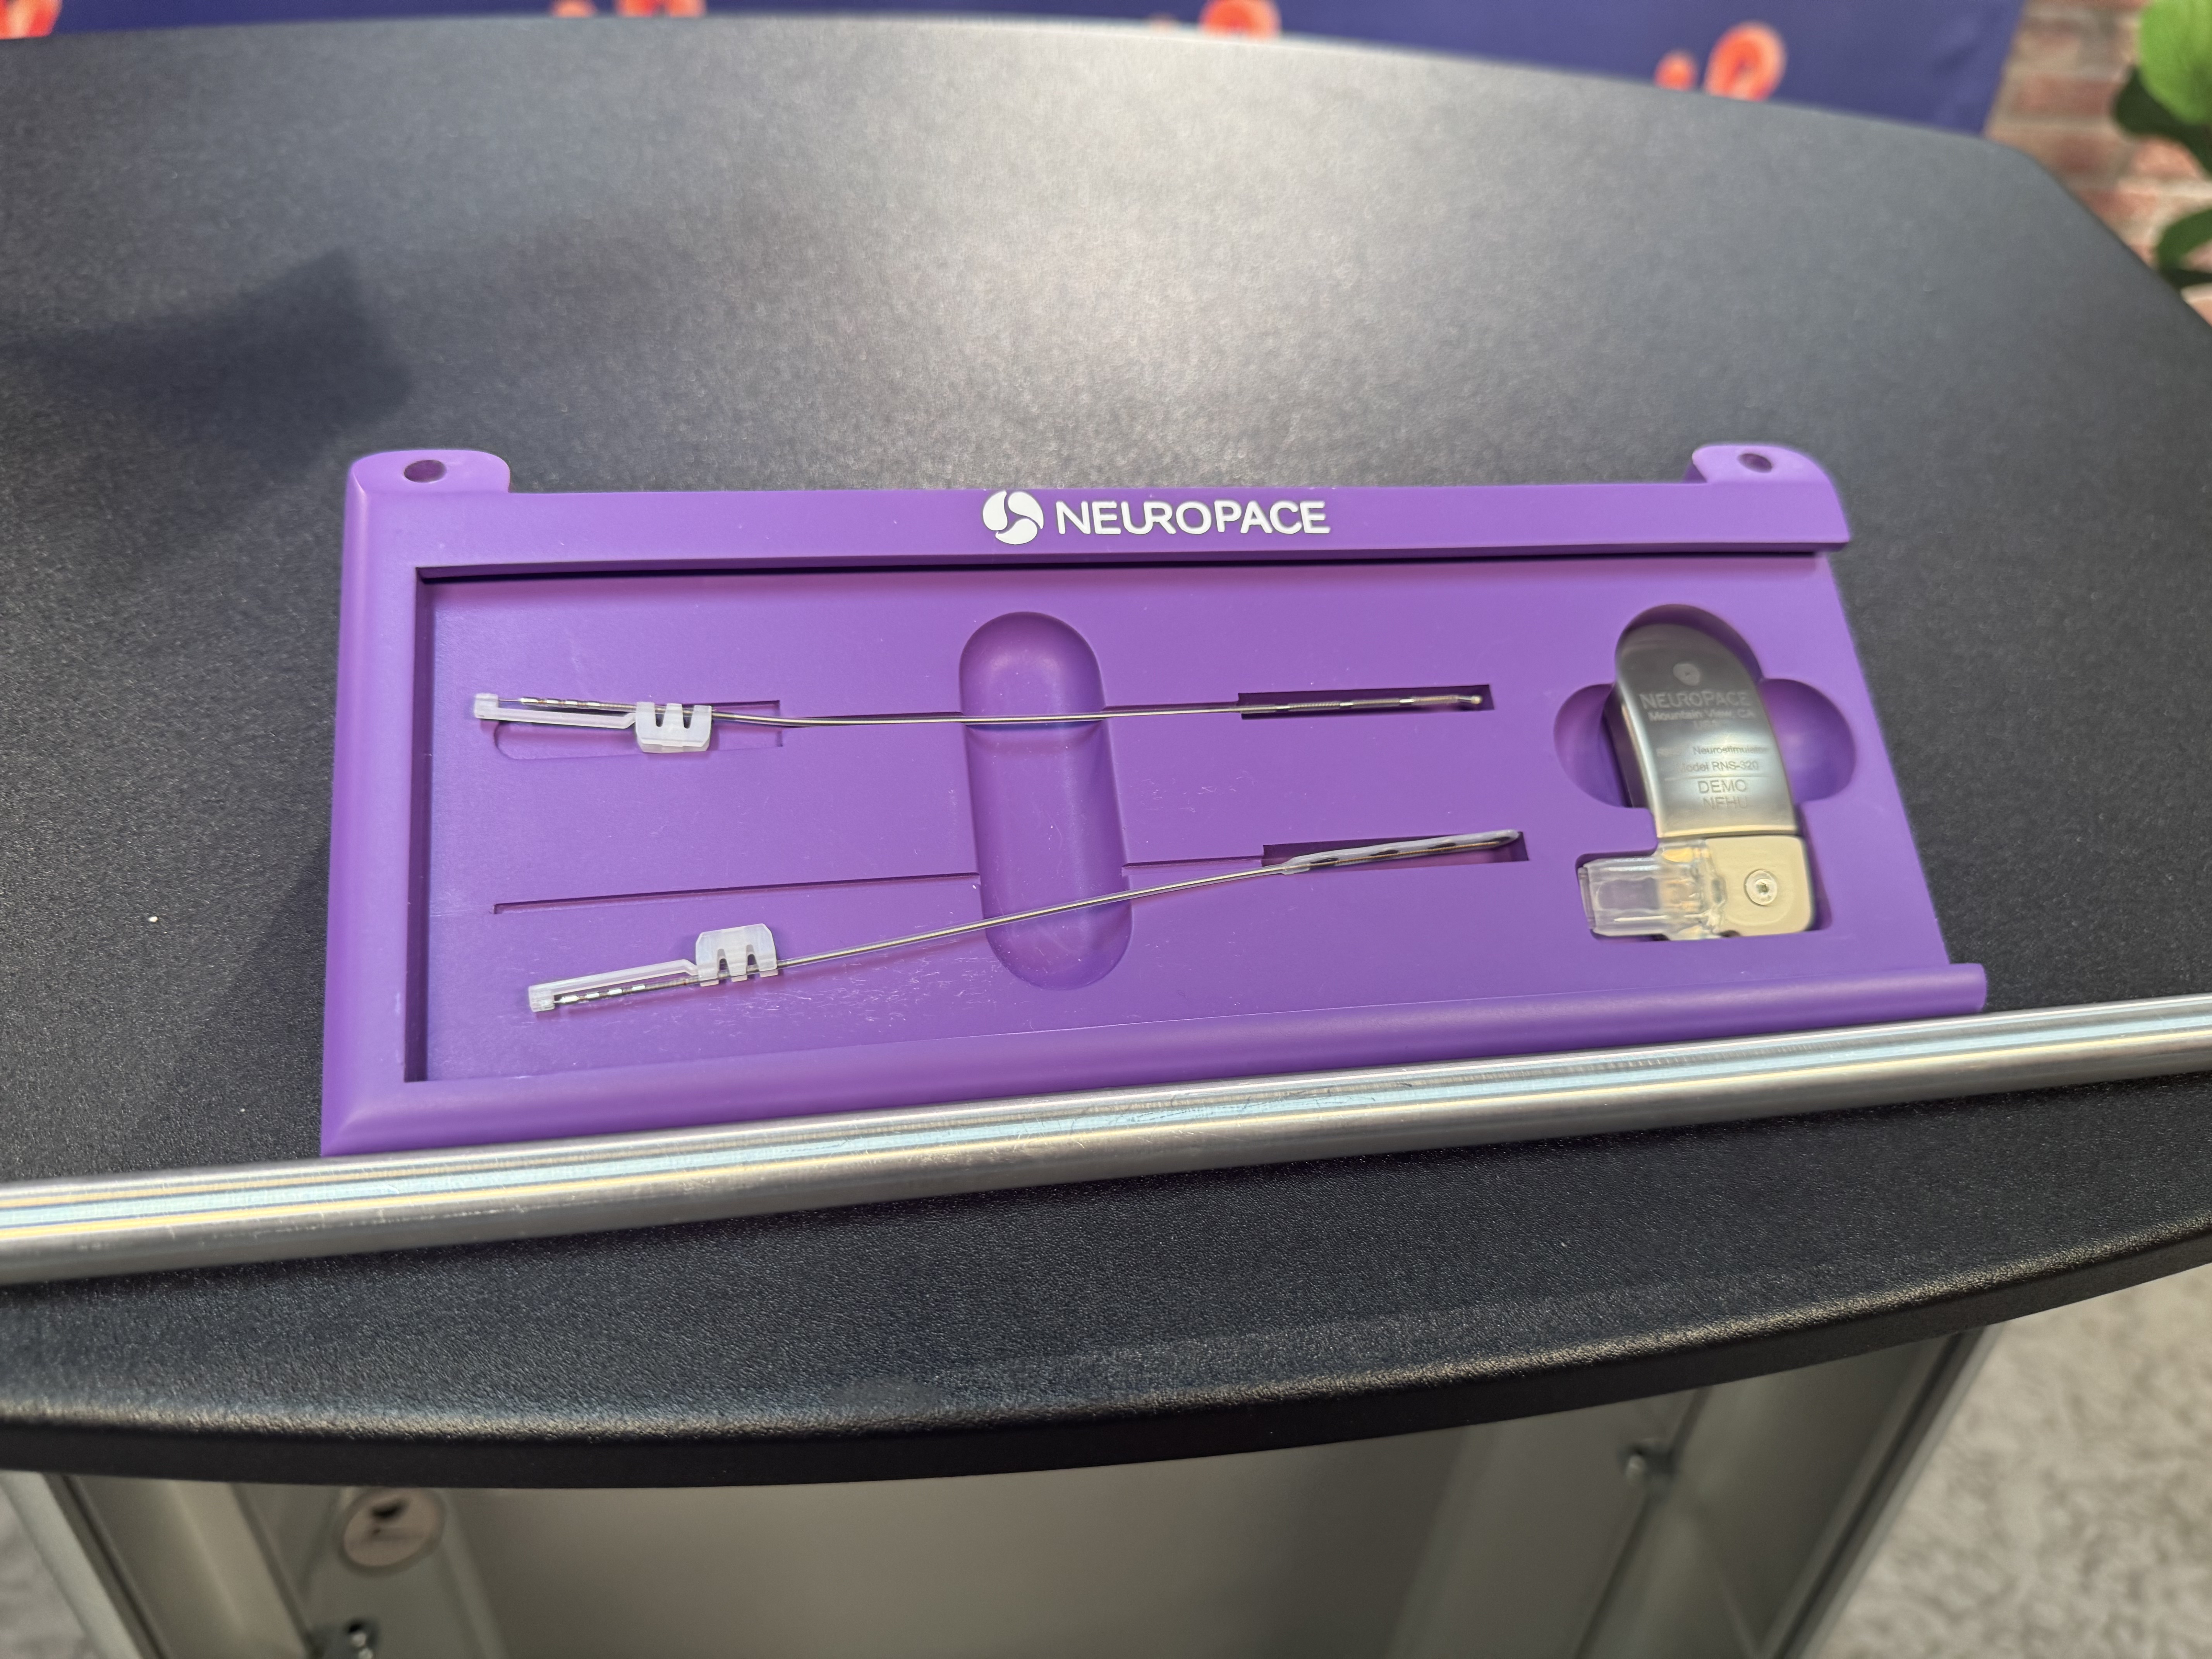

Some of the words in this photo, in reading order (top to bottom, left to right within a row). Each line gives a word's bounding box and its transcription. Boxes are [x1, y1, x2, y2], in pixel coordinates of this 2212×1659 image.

[1056, 500, 1331, 535] NEUROPACE
[1639, 690, 1752, 709] NEUROPACE
[1711, 760, 1759, 771] RNS-320
[1697, 779, 1747, 793] DEMO
